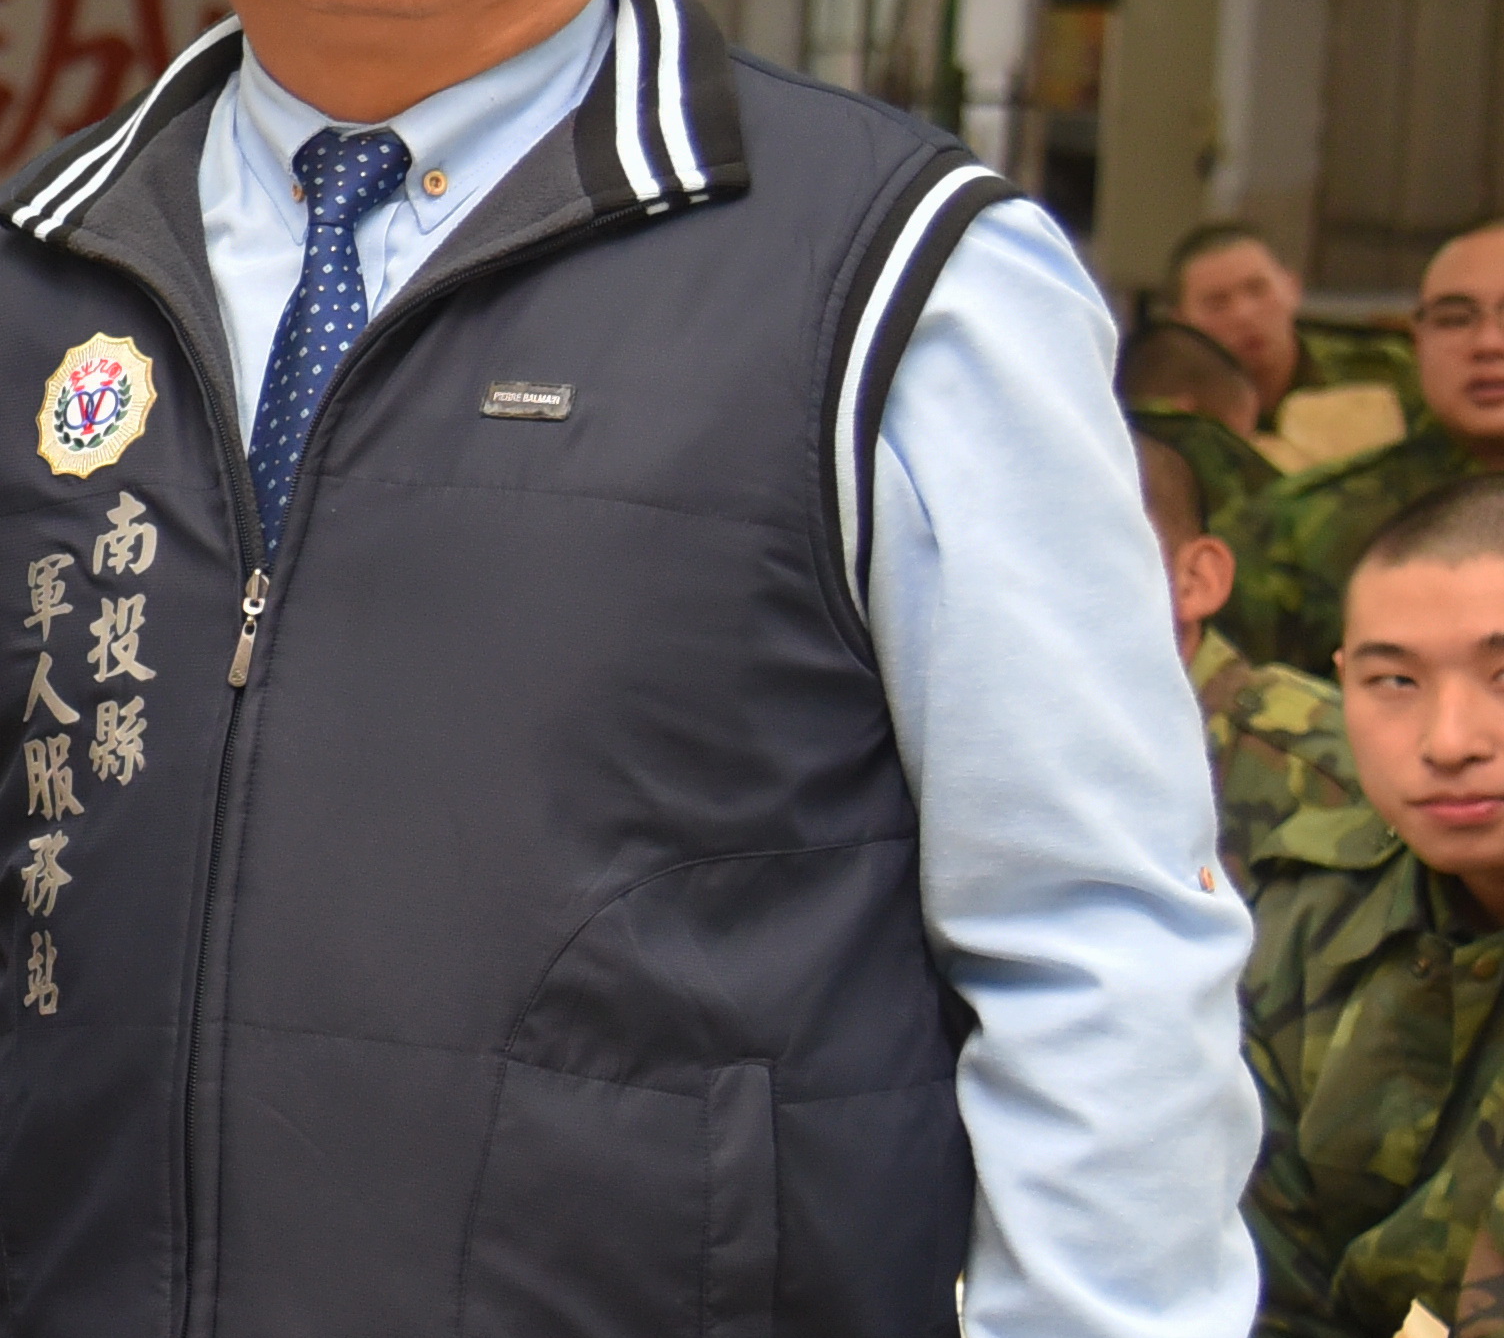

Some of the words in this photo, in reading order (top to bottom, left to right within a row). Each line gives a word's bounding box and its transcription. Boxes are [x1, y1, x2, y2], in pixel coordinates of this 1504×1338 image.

[22, 553, 86, 1017] 軍人服務站
[86, 490, 157, 786] 南投縣
